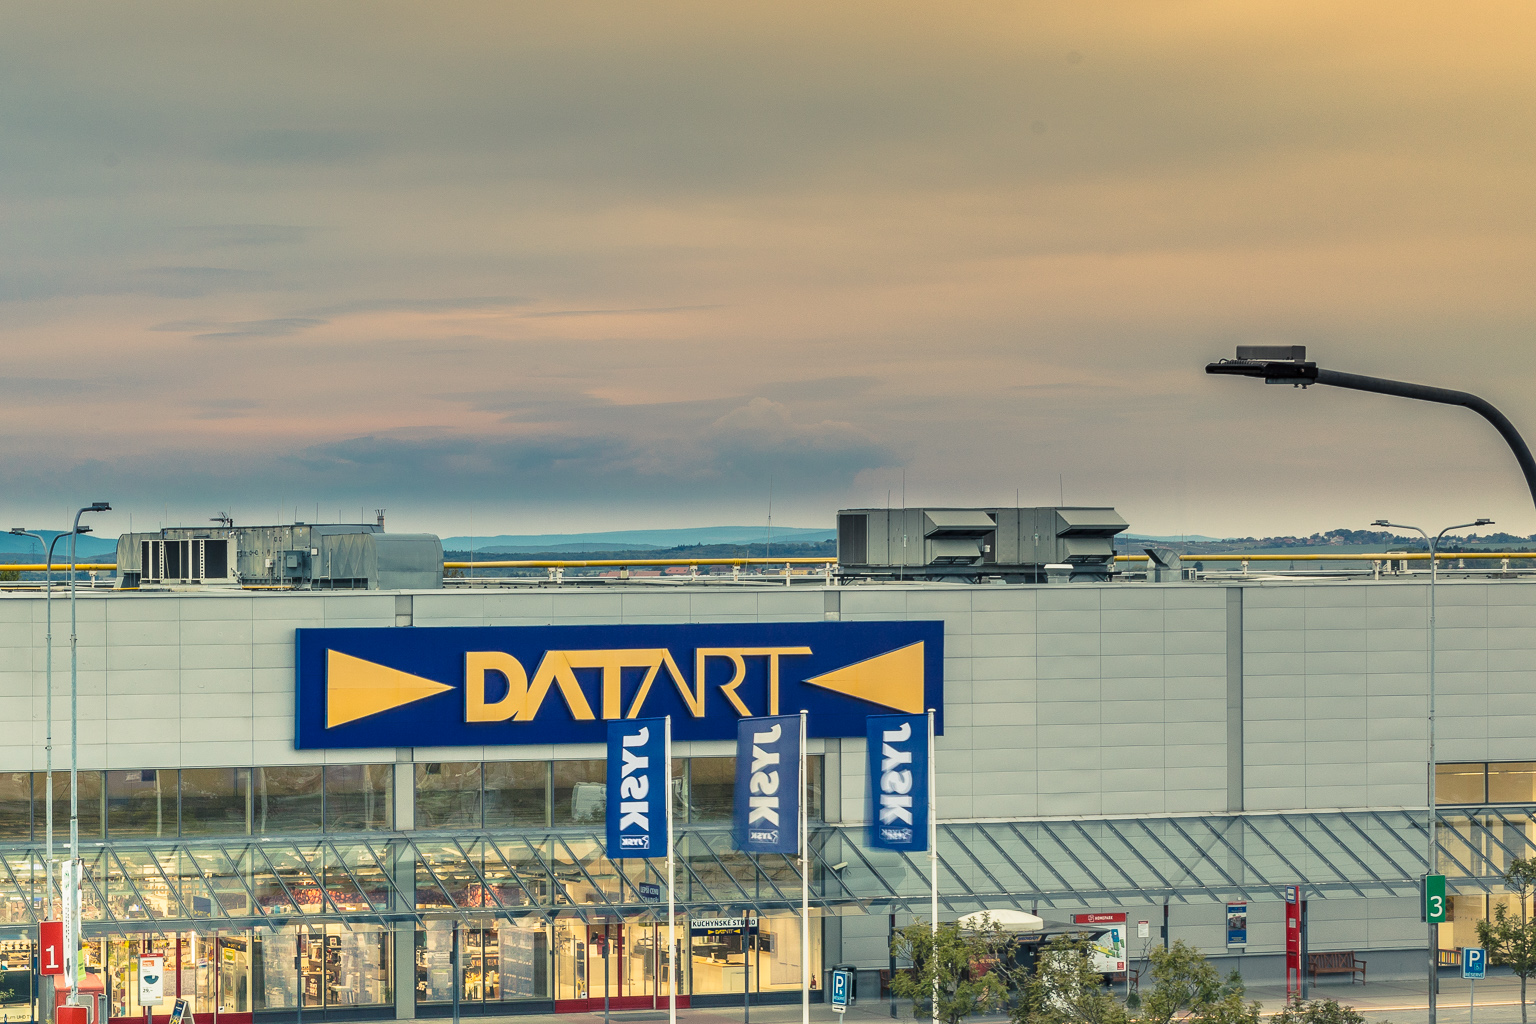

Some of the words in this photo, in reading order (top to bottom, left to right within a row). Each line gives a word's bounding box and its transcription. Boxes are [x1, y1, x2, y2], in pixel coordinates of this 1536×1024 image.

[466, 646, 813, 723] DATART
[1430, 895, 1443, 917] 3
[733, 918, 756, 926] STUIO
[46, 944, 59, 969] 1
[1469, 950, 1481, 967] P
[835, 975, 844, 994] P
